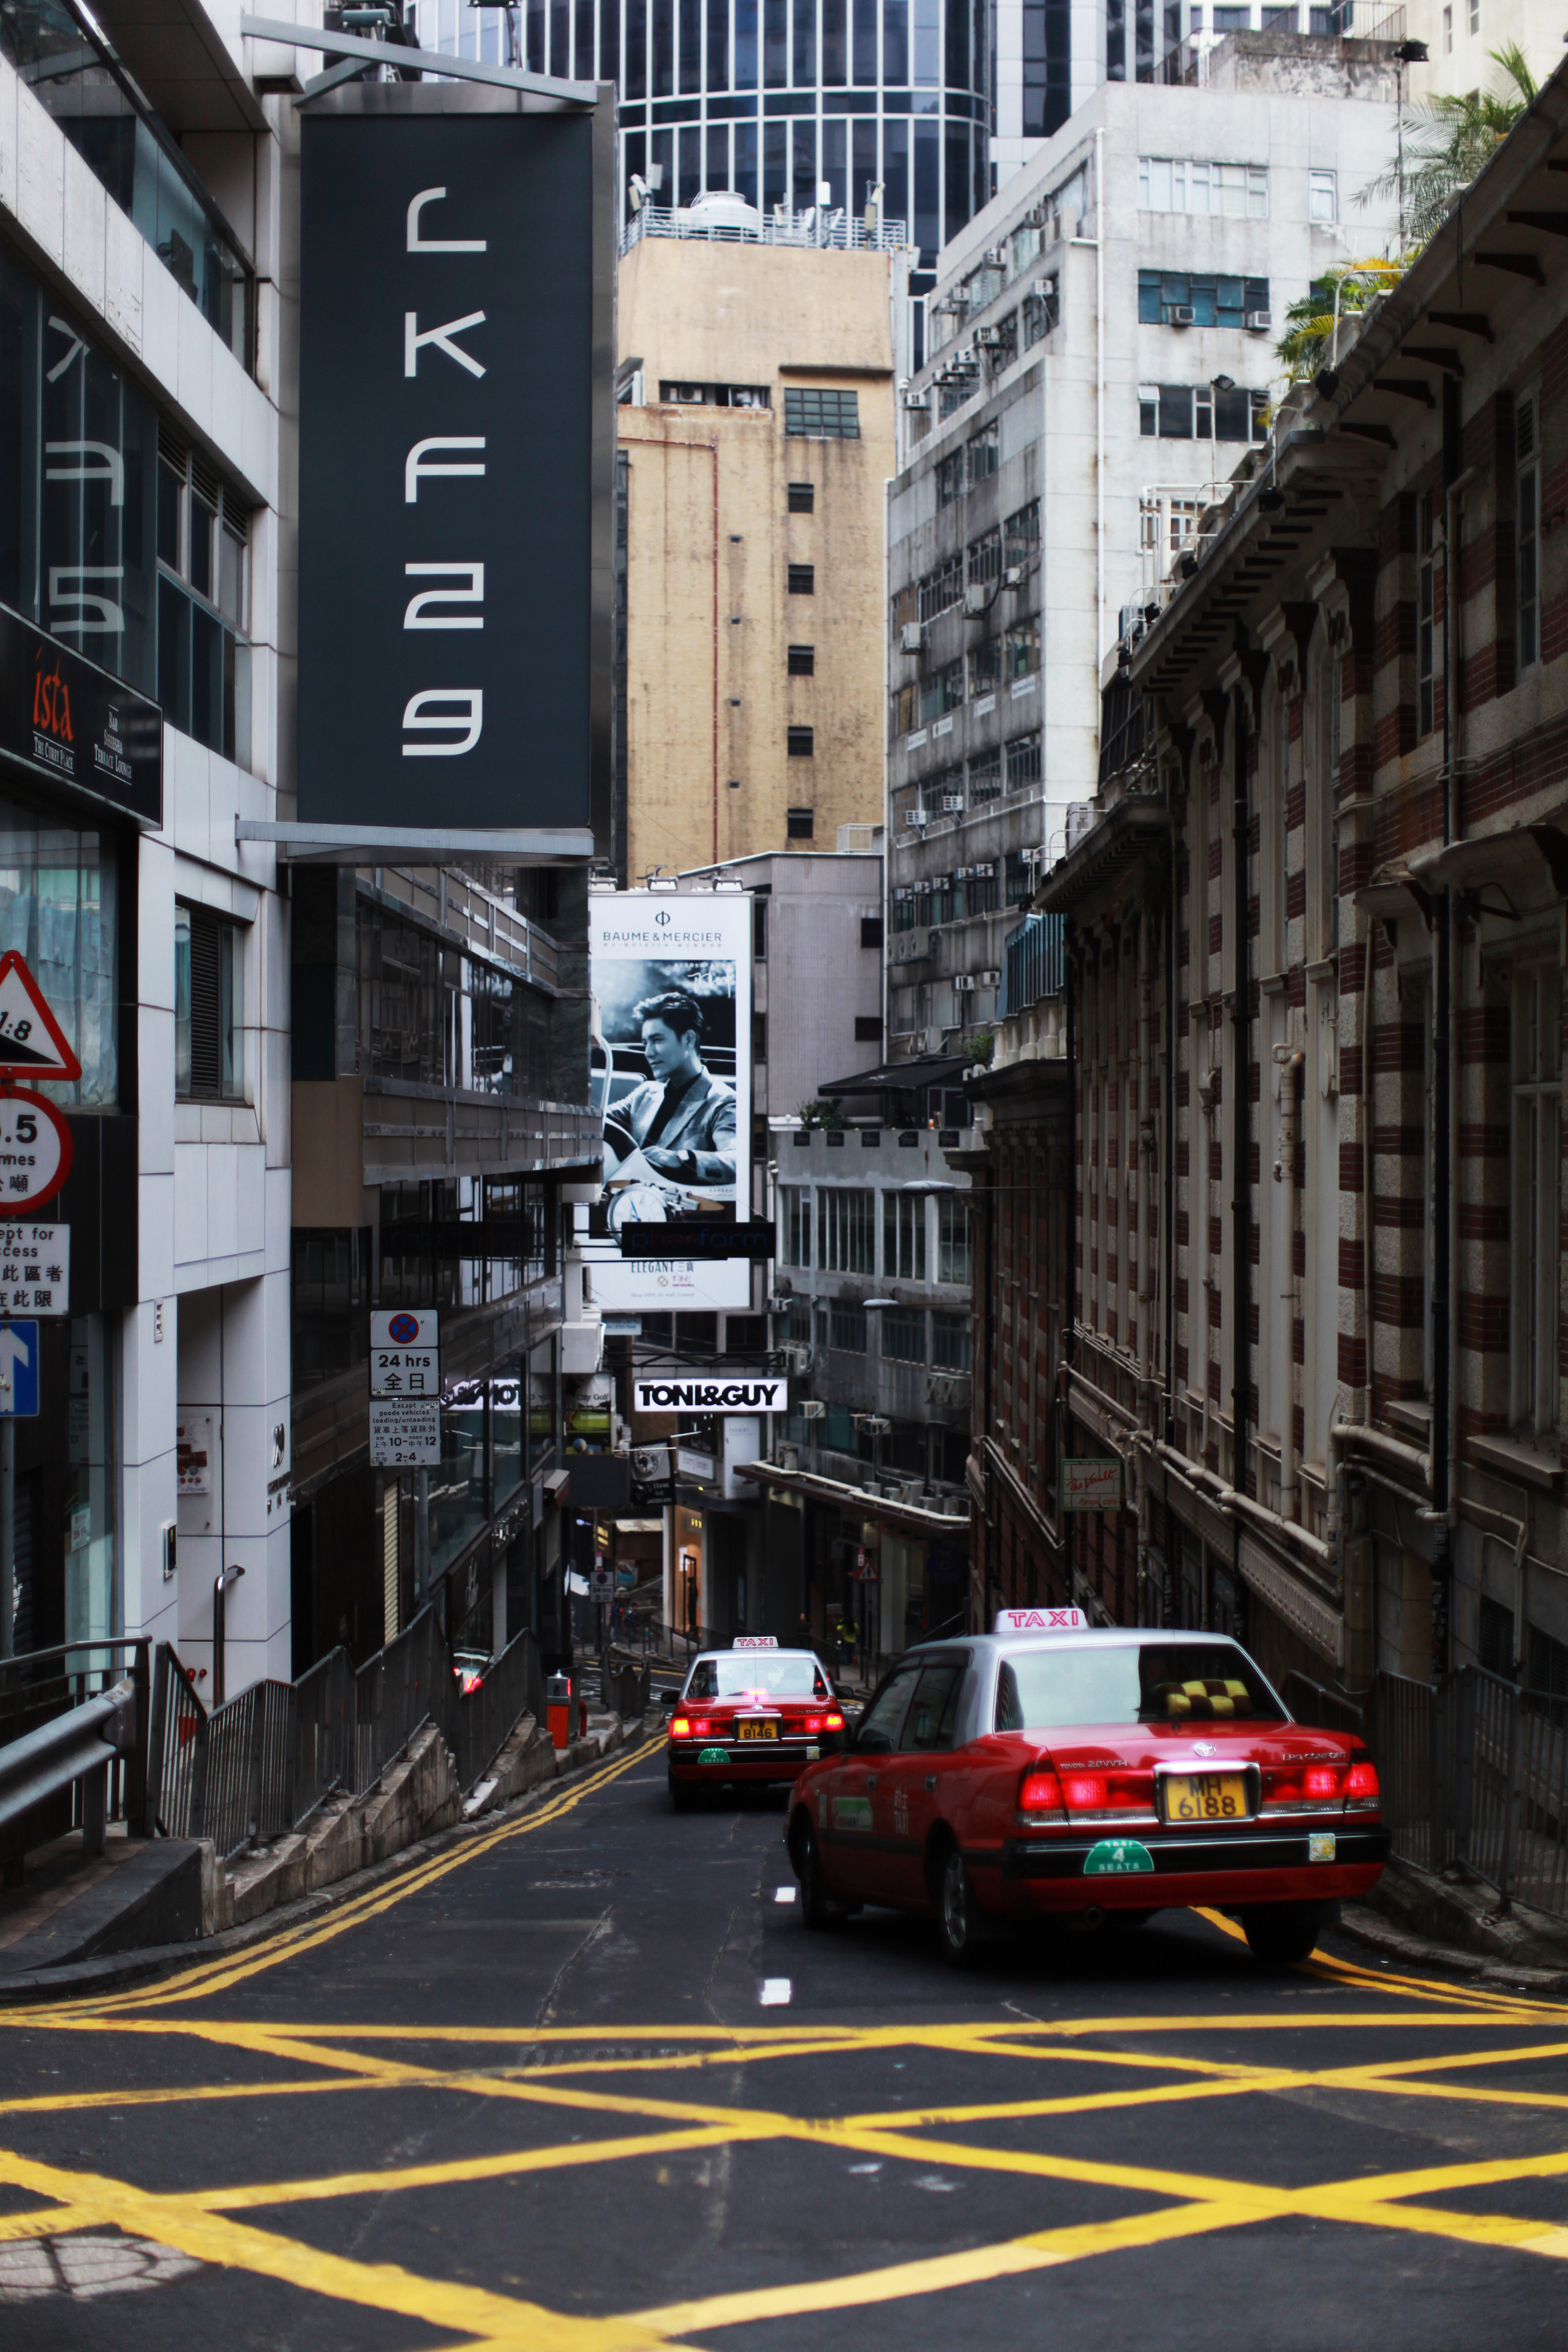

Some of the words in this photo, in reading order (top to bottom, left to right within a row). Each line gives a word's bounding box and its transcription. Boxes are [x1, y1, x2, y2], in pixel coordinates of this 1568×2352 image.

[109, 711, 118, 733] BAR
[104, 729, 123, 755] SHEESHA
[34, 737, 43, 753] THE
[45, 742, 59, 763] CURRY
[60, 750, 73, 770] PLACE
[94, 744, 114, 770] TERRACE
[115, 756, 132, 779] LOUNGE
[0, 1114, 37, 1144] .5
[32, 1227, 54, 1240] for
[0, 1246, 38, 1257] cess
[2, 1264, 63, 1282] 此區者
[631, 1261, 675, 1273] ELEGANT
[379, 1354, 401, 1368] 24
[405, 1354, 431, 1367] hrs
[384, 1373, 424, 1390] 全日
[639, 1384, 779, 1406] TONI&GUY
[374, 1425, 436, 1434] 貨車上落貨除外
[424, 1436, 436, 1446] 12
[395, 1452, 417, 1462] 2-4
[1066, 1477, 1083, 1491] The
[1085, 1469, 1118, 1489] Vault
[1008, 1610, 1079, 1628] TAXI
[737, 1637, 774, 1646] TAXI
[744, 1728, 772, 1738] 8146
[1189, 1775, 1223, 1797] MH
[1178, 1796, 1237, 1818] 6188
[894, 1810, 908, 1834] TAXI
[1112, 1848, 1125, 1862] 4
[1099, 1863, 1140, 1871] SEATS
